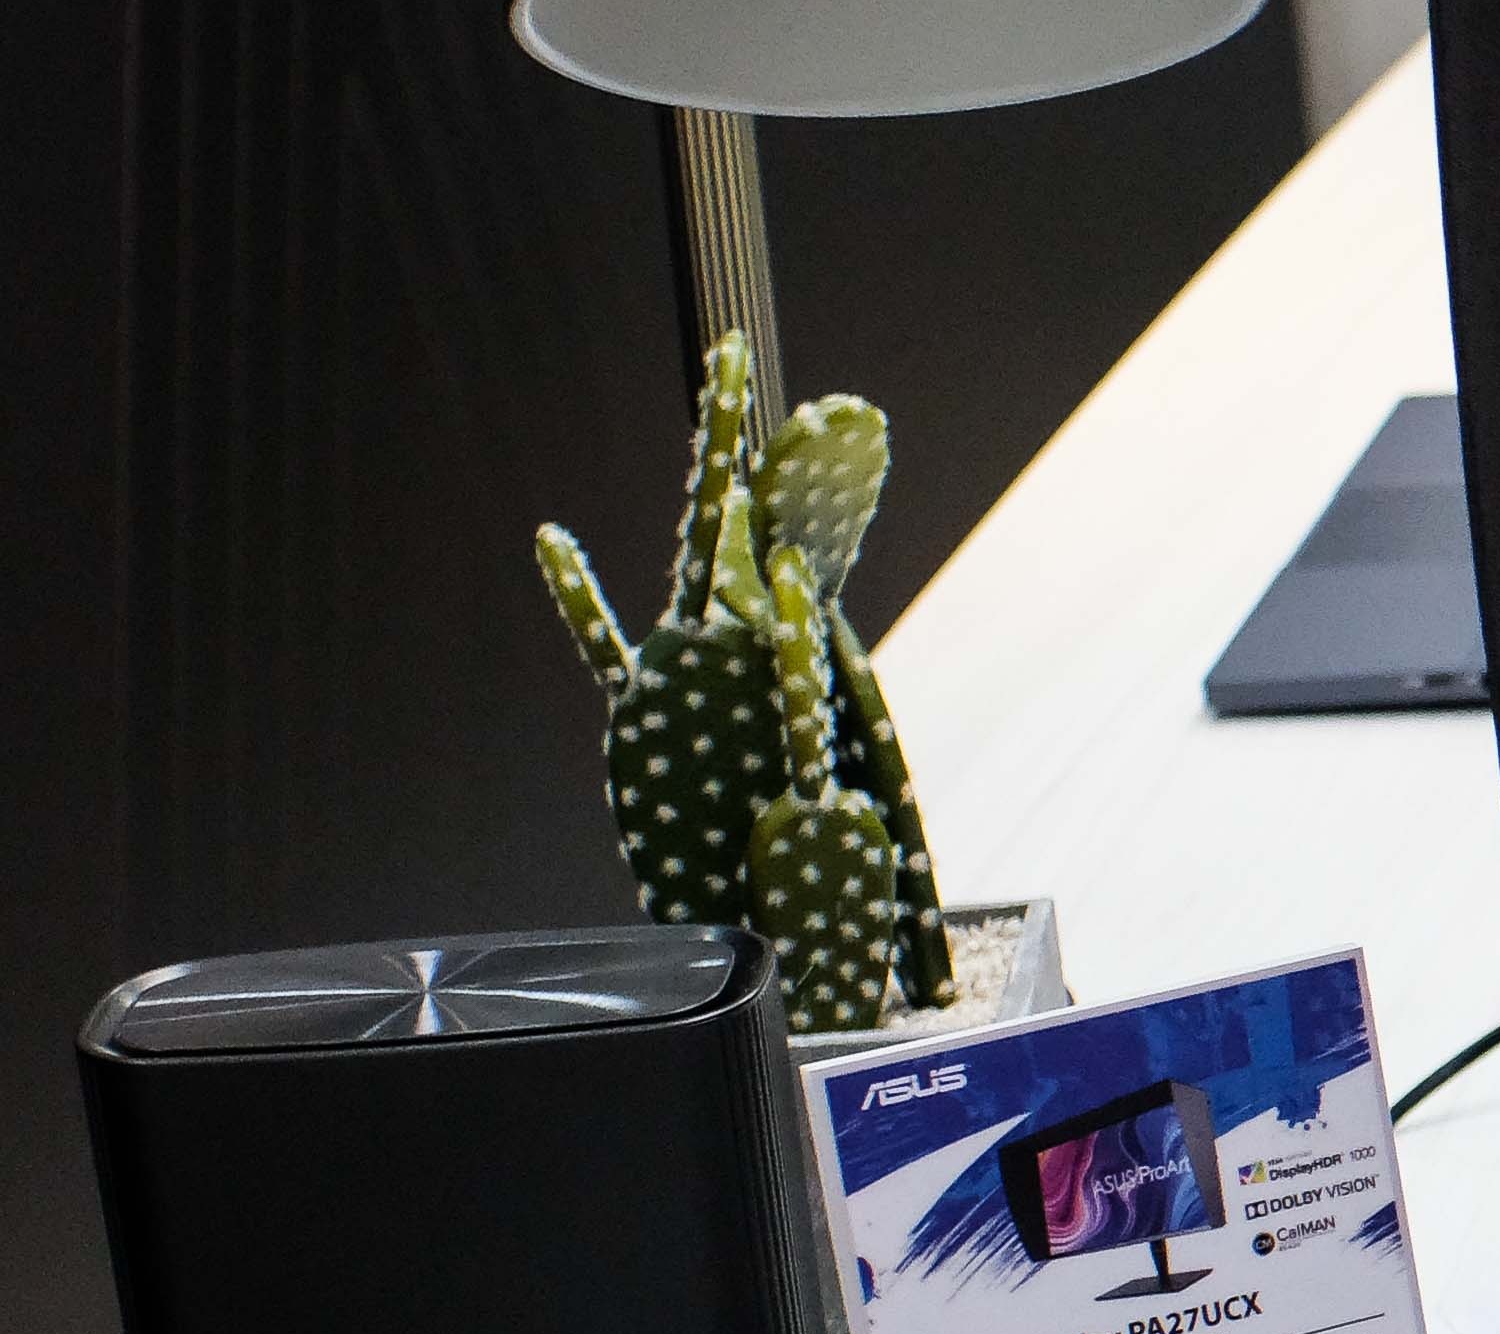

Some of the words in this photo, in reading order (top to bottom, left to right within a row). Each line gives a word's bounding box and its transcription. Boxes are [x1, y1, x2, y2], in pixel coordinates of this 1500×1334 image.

[860, 1064, 967, 1111] ASUS
[1090, 1169, 1136, 1199] ASUS
[1135, 1154, 1193, 1184] ProArt
[1269, 1187, 1322, 1213] DOLBY
[1324, 1175, 1375, 1198] VISION
[1276, 1215, 1335, 1241] CalMAN
